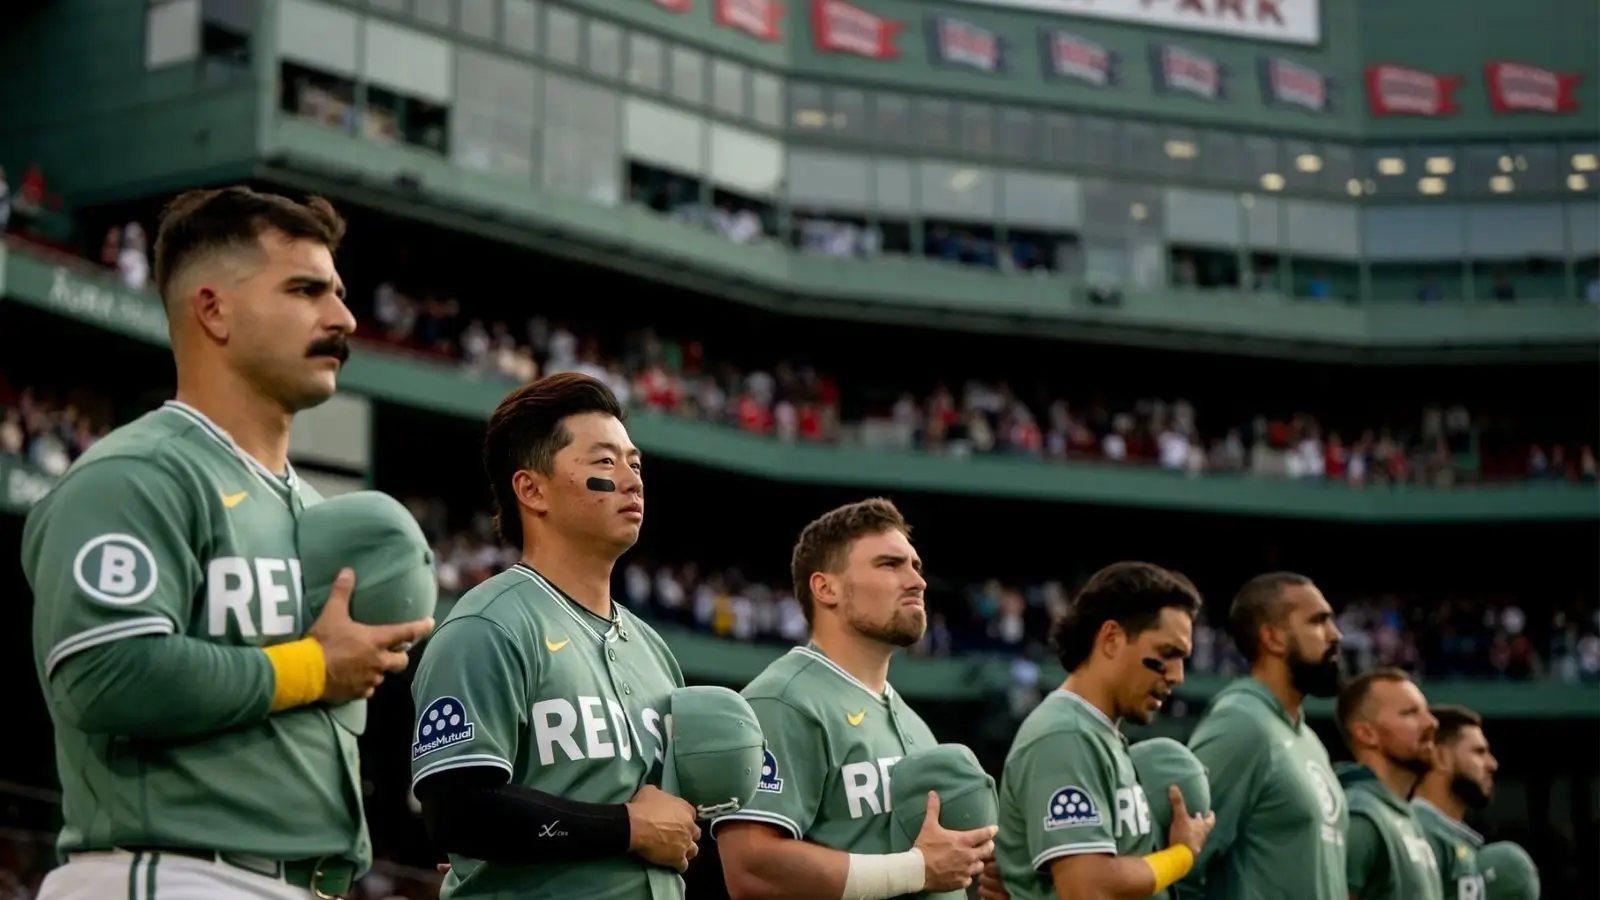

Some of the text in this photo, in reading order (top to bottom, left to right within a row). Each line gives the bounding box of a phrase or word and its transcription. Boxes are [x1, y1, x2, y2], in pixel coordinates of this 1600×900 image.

[1139, 0, 1286, 26] RK
[100, 544, 136, 594] B
[414, 726, 471, 757] MassMutual
[532, 695, 672, 766] RED S
